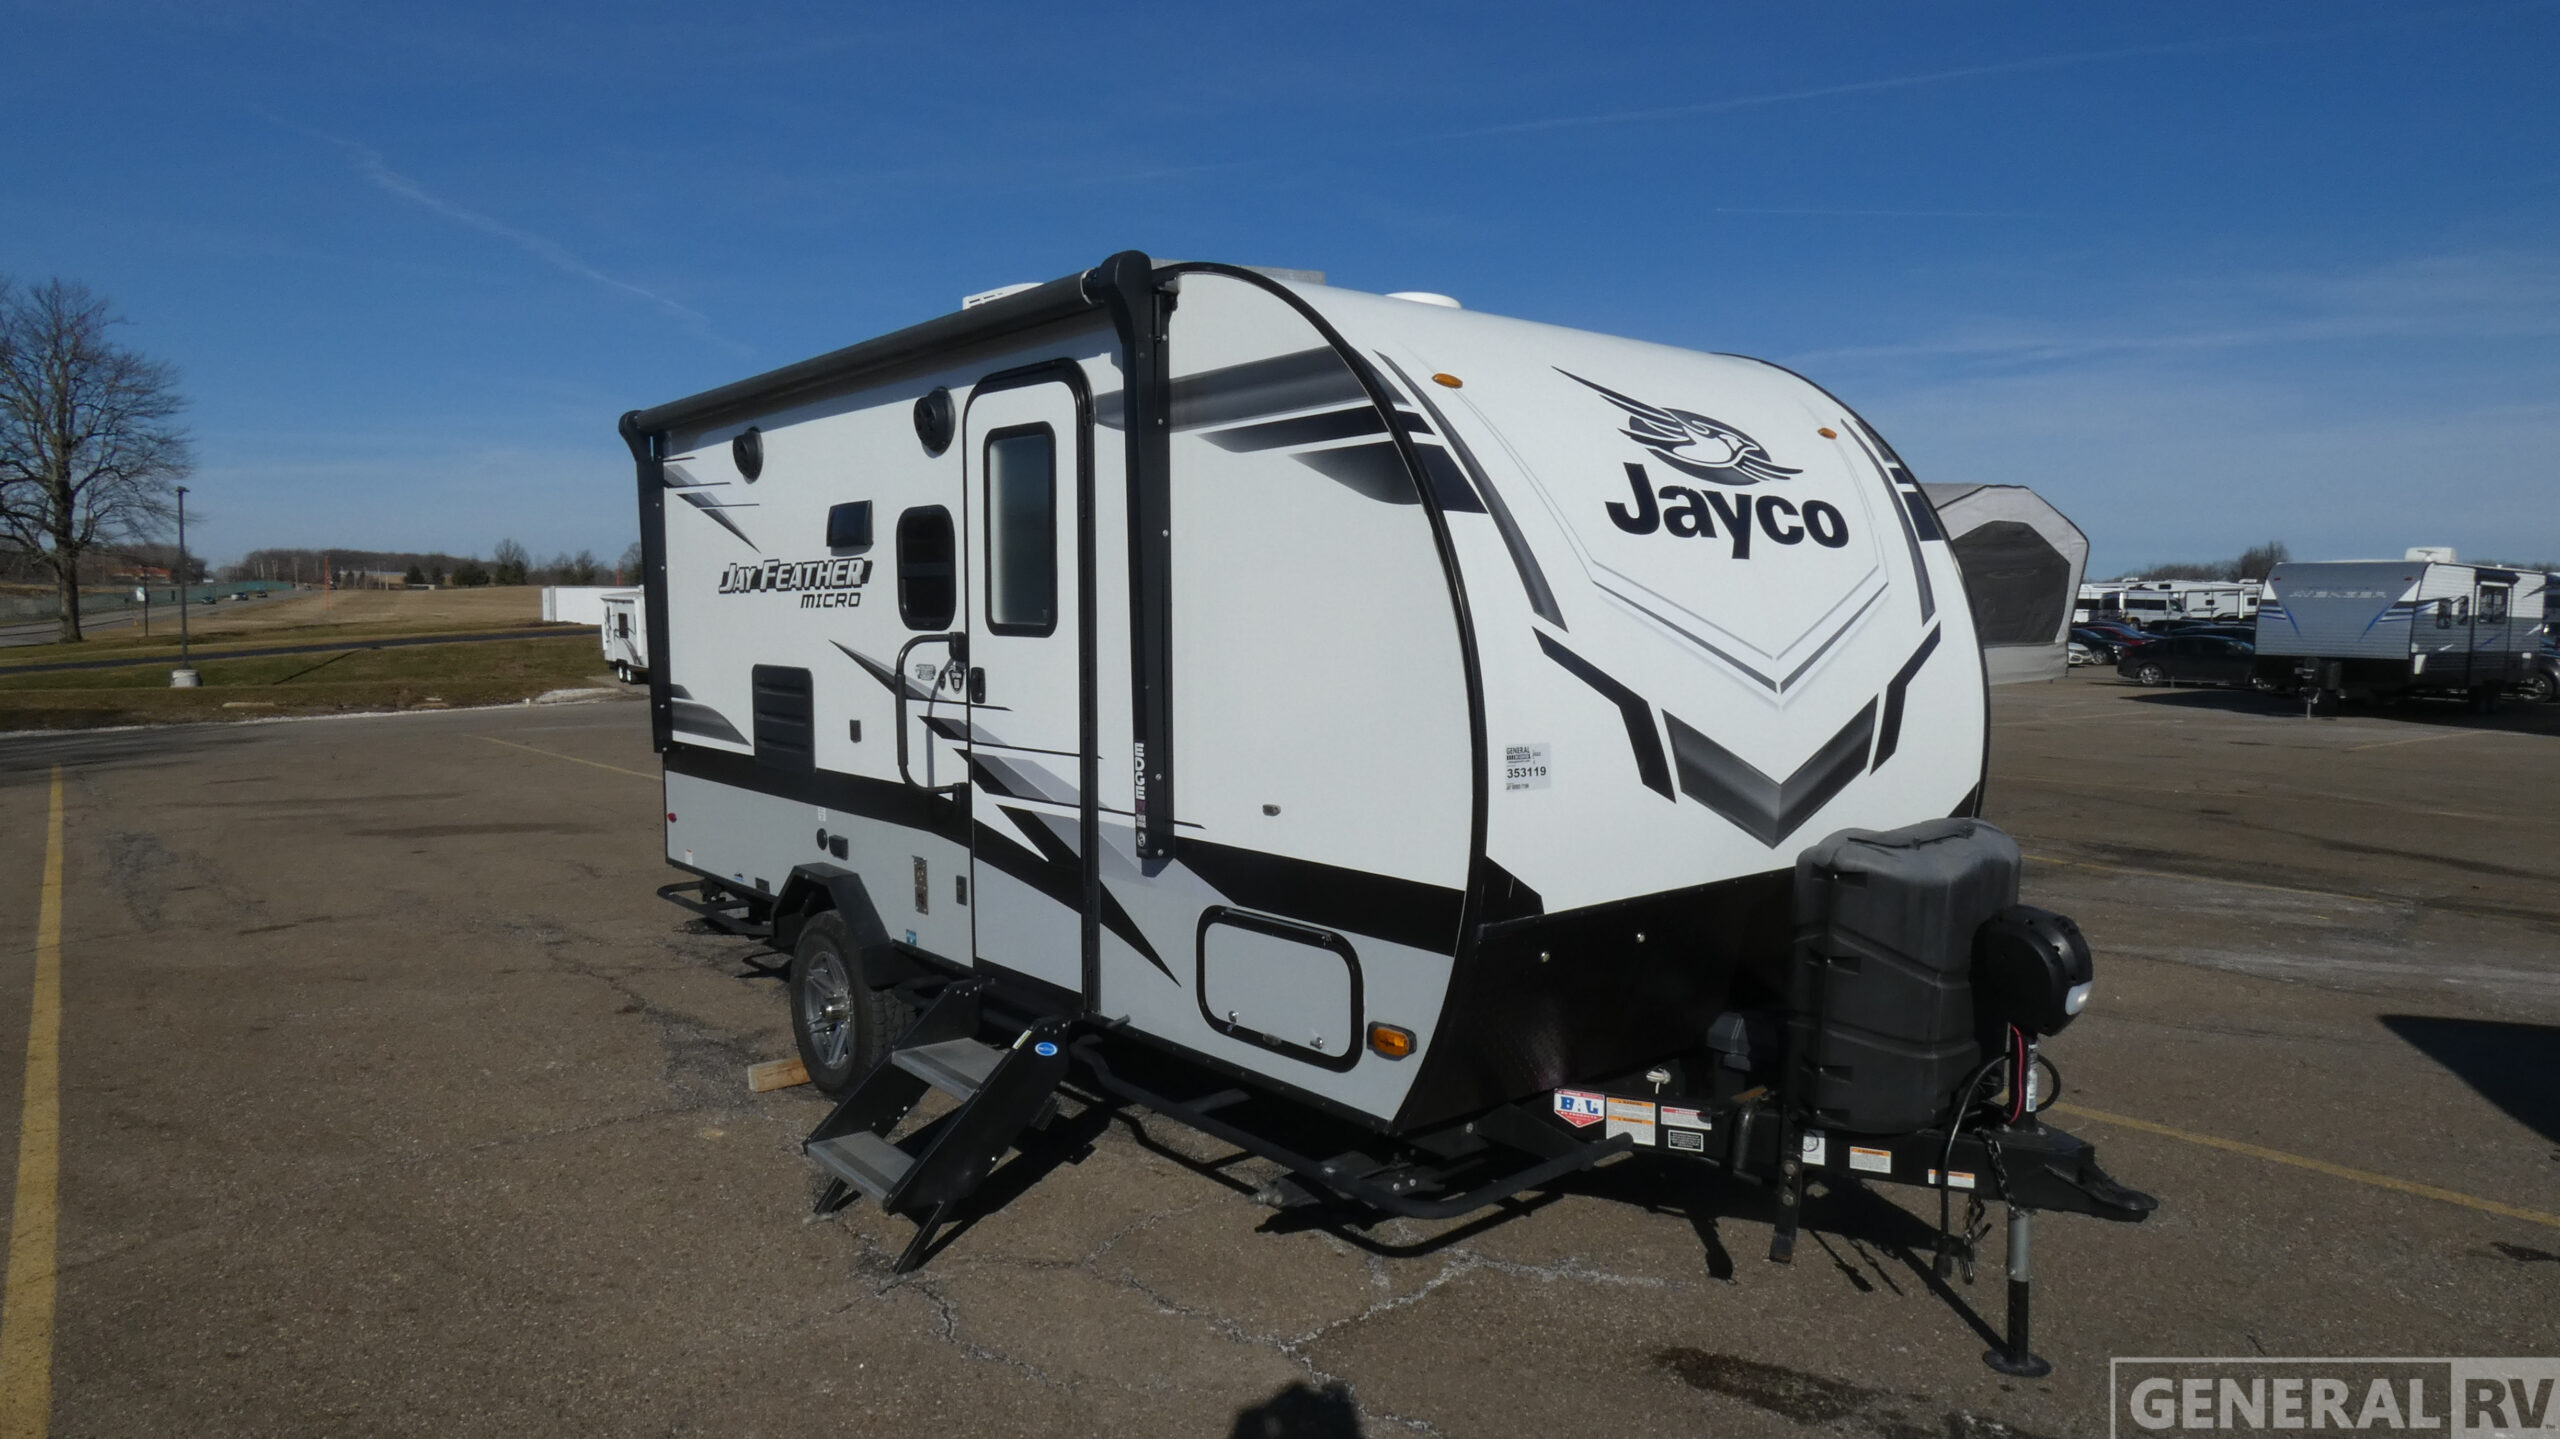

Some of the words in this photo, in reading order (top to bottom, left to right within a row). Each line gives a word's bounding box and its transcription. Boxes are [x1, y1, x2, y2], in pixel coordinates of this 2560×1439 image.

[1604, 462, 1849, 560] Jayco
[719, 563, 757, 594] JAY
[759, 557, 870, 592] FEATHER
[800, 592, 862, 608] MICRO
[1134, 742, 1146, 800] EDGE
[1506, 766, 1547, 779] 353119
